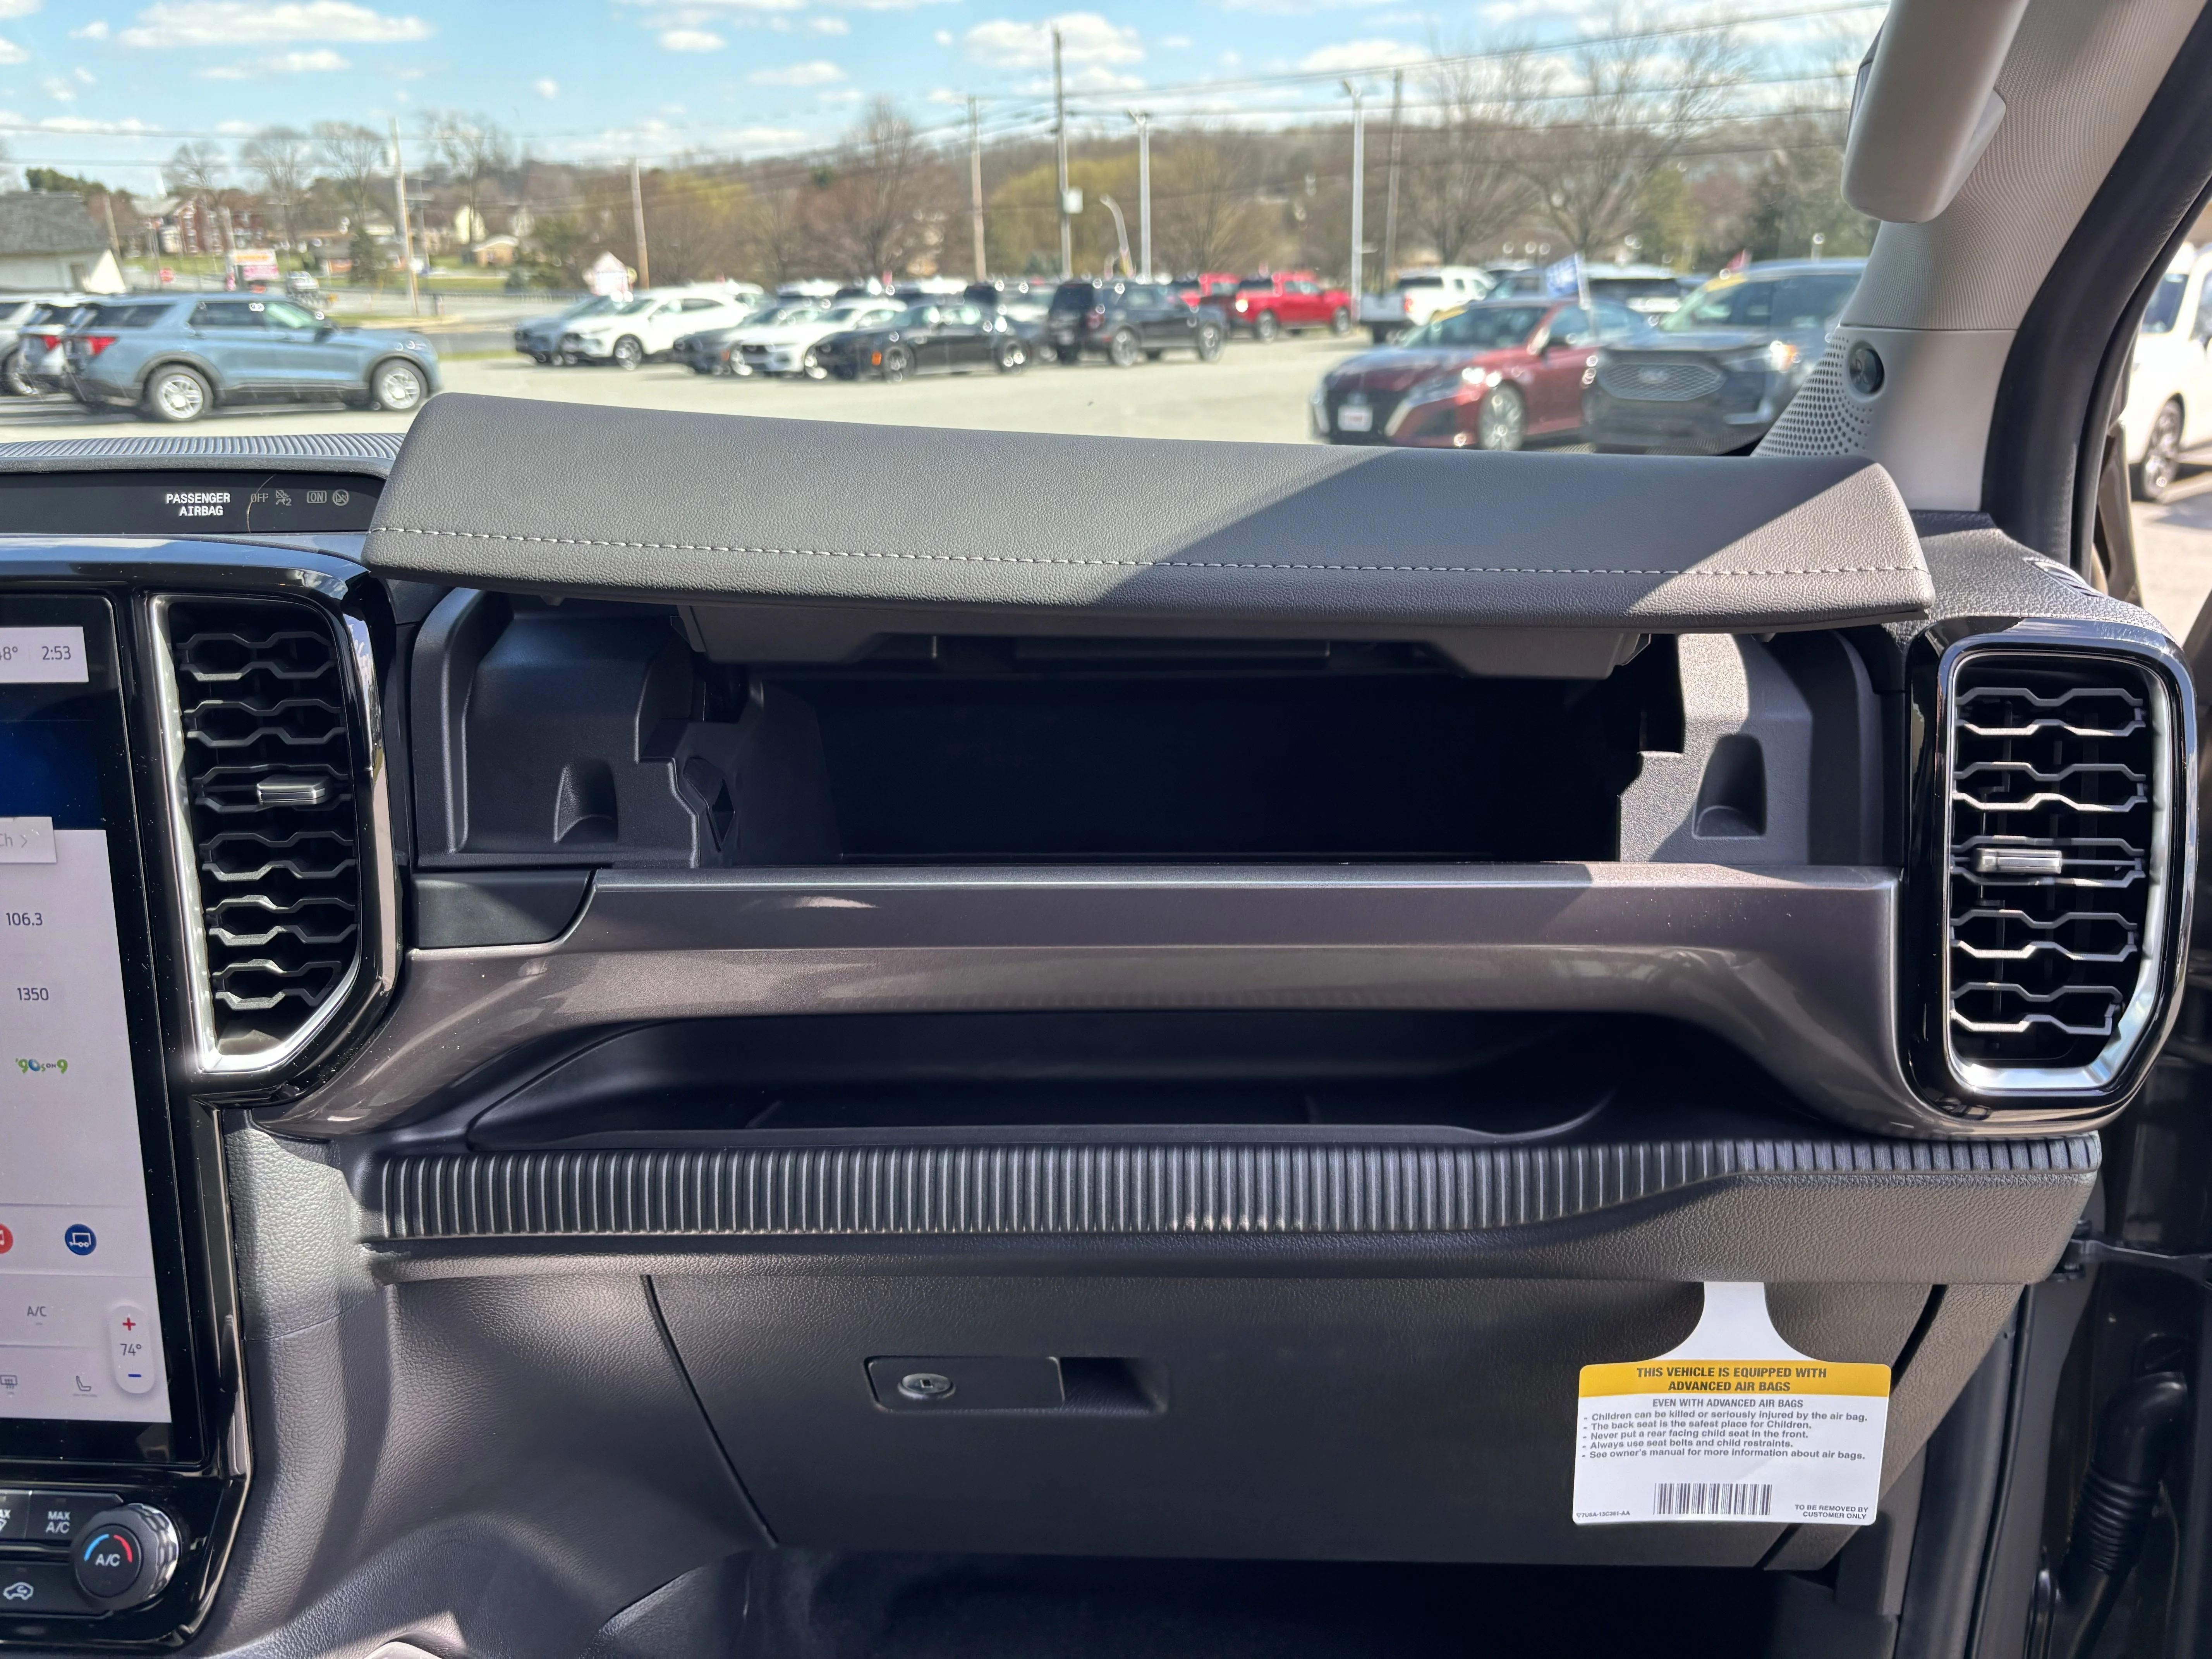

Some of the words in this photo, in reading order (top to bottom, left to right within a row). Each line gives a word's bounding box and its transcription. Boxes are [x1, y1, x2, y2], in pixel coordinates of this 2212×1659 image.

[166, 493, 230, 503] PASSENGER
[310, 492, 323, 502] ON
[179, 506, 223, 517] AIRBAG
[41, 646, 71, 661] 2:53
[6, 912, 43, 926] 106.3
[17, 988, 49, 1001] 1350
[27, 1306, 47, 1317] A/C
[120, 1343, 142, 1356] 74°
[1637, 1367, 1663, 1377] THIS
[1667, 1367, 1715, 1377] VEHICLE
[1718, 1367, 1729, 1377] IS
[1734, 1367, 1791, 1377] EQUIPPED
[1796, 1368, 1827, 1377] WITH
[1668, 1381, 1731, 1391] ADVANCED
[1735, 1382, 1755, 1391] AIR
[1759, 1382, 1791, 1391] BAGS
[1653, 1398, 1676, 1407] EVEN
[1680, 1398, 1703, 1407] WITH
[1707, 1399, 1756, 1407] ADVANCED
[1759, 1399, 1775, 1407] AIR
[1778, 1400, 1803, 1408] BAGS
[1592, 1413, 1631, 1421] Children
[1711, 1410, 1756, 1419] seriously
[1759, 1411, 1793, 1419] injured
[1796, 1412, 1808, 1420] by
[1846, 1413, 1867, 1422] bag.
[1591, 1422, 1609, 1431] The
[1721, 1420, 1747, 1429] place
[1767, 1420, 1812, 1429] Children.
[1621, 1431, 1636, 1439] put
[1669, 1429, 1698, 1438] facing
[1610, 1449, 1647, 1457] owner's
[1732, 1448, 1788, 1456] information
[1791, 1449, 1819, 1458] about
[1838, 1451, 1865, 1460] bags.
[48, 1511, 70, 1521] MAX
[46, 1522, 70, 1534] A/C
[95, 1554, 120, 1566] A/C
